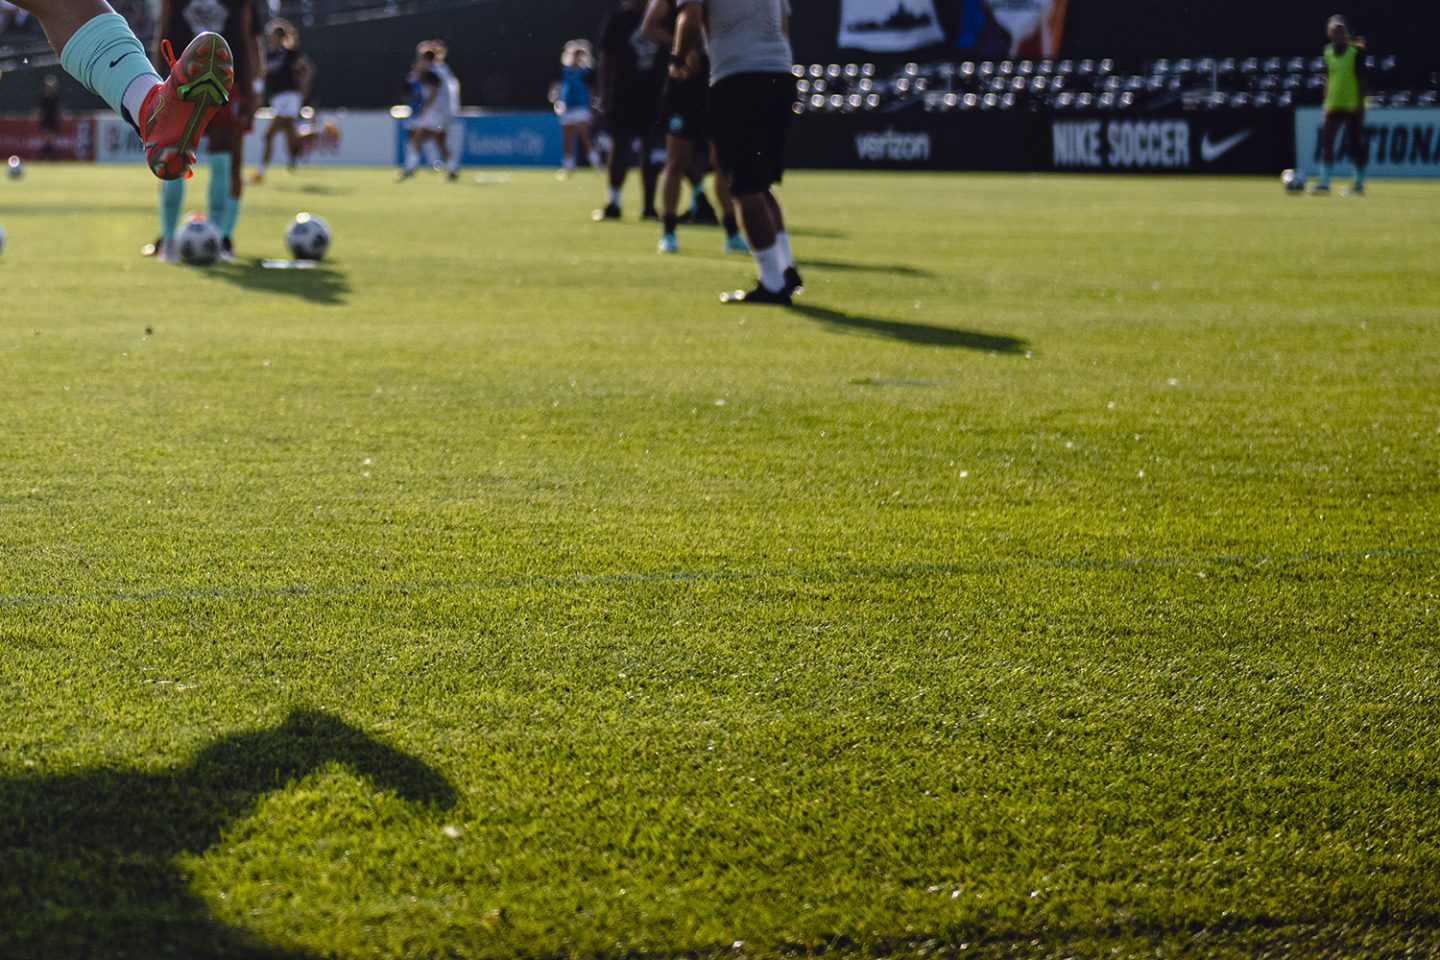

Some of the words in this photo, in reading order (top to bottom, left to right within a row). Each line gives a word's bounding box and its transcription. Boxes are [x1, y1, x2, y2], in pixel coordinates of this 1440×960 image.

[854, 129, 930, 159] verizon
[1053, 121, 1101, 166] NIKE
[1107, 121, 1189, 167] SOCCER
